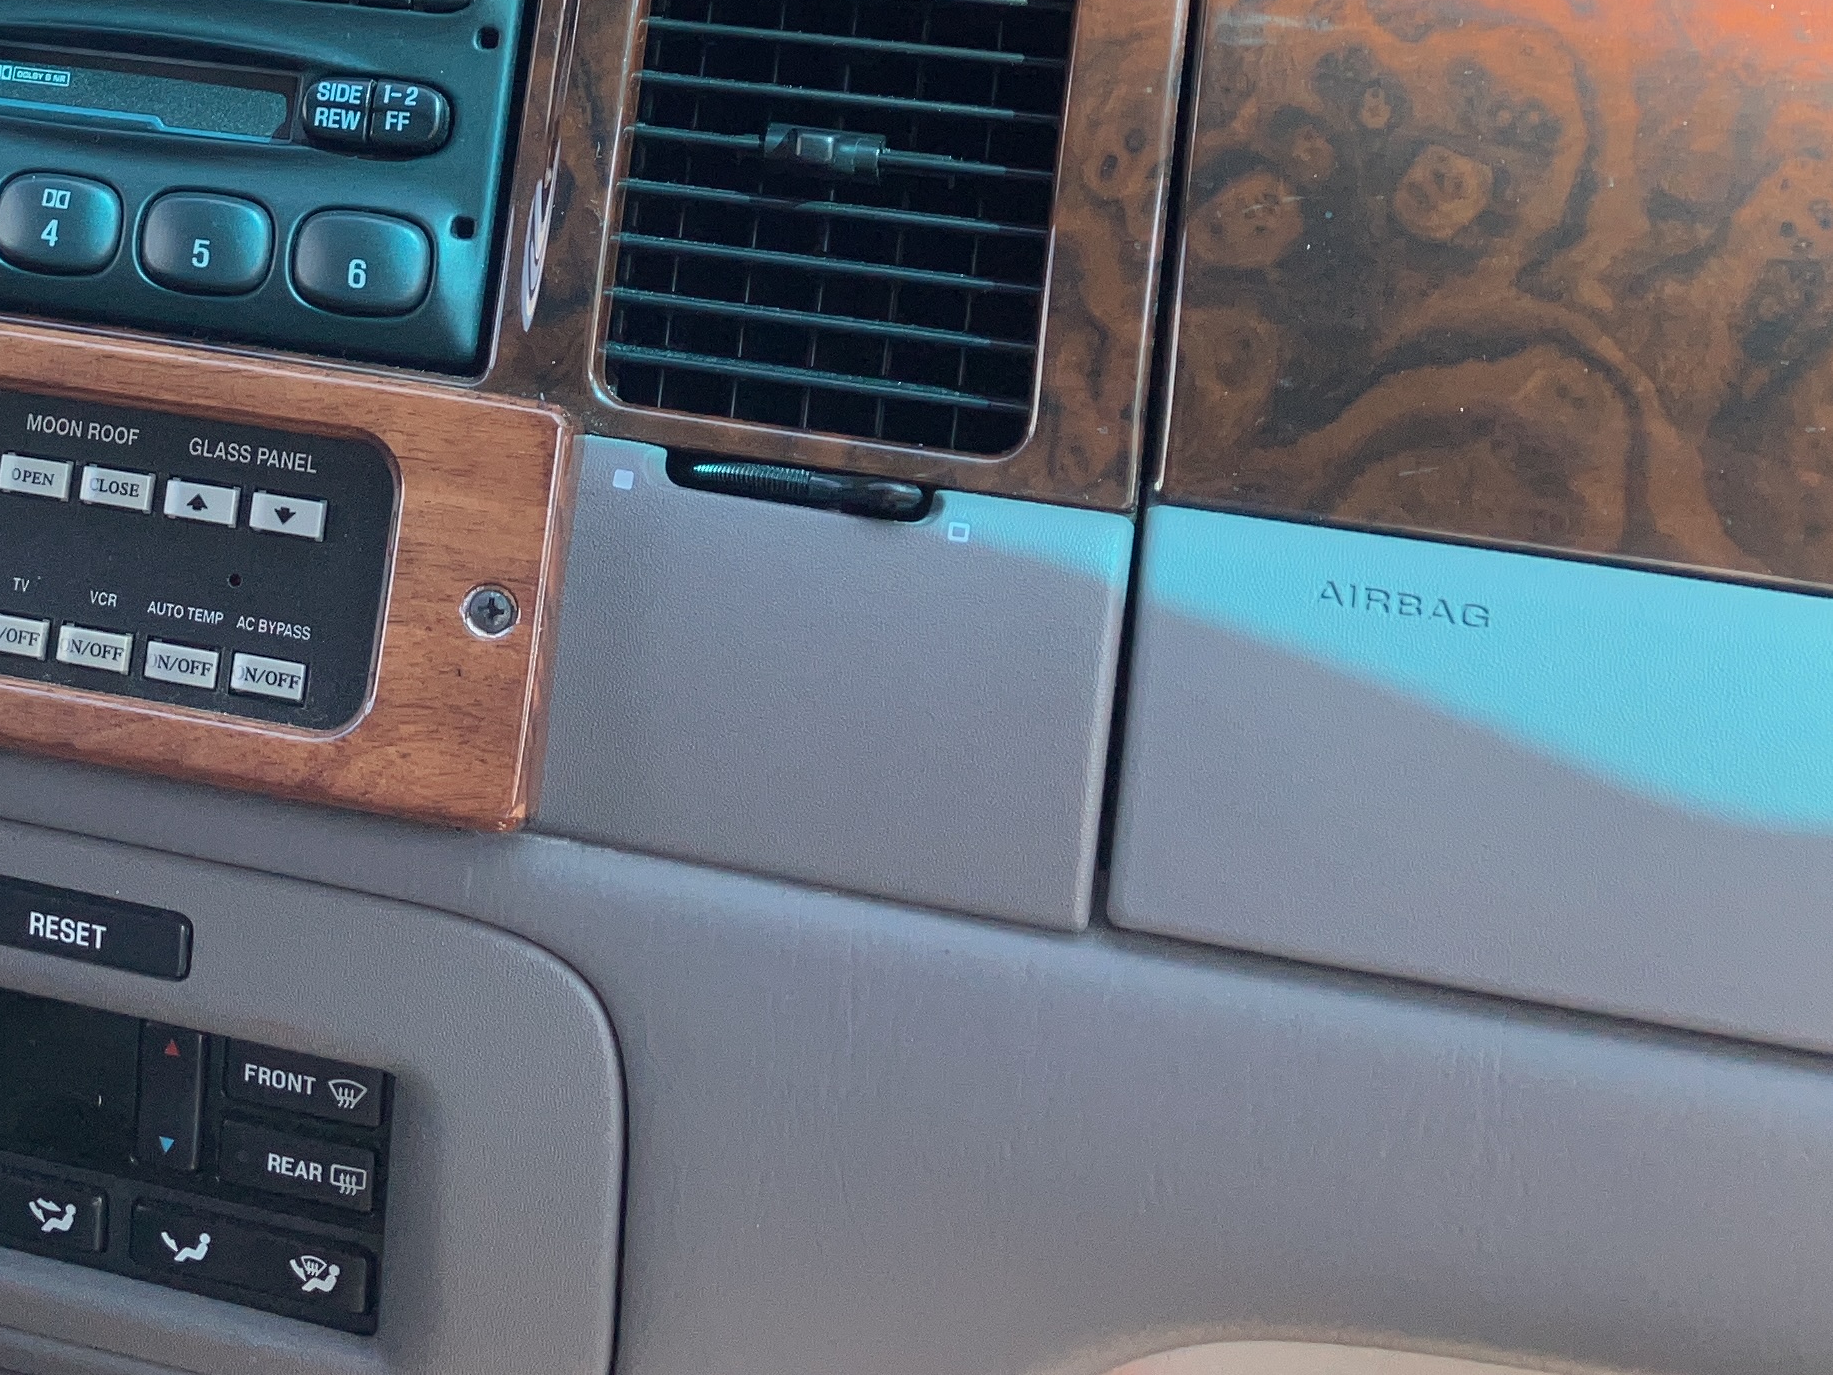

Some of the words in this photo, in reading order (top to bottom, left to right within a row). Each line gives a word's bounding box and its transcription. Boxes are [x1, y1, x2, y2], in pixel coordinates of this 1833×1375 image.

[316, 81, 362, 106] SIDE
[314, 107, 361, 132] REW
[384, 110, 411, 132] FF
[40, 217, 59, 248] 4
[191, 238, 210, 269] 5
[347, 258, 366, 289] 6
[26, 413, 83, 439] MOON
[87, 422, 140, 446] ROOF
[189, 437, 252, 464] GLASS
[256, 447, 317, 474] PANEL
[11, 467, 56, 486] OPEN
[89, 477, 140, 499] CLOSE
[13, 577, 30, 592] TV
[90, 590, 117, 607] VCR
[147, 601, 184, 618] AUTO
[187, 607, 224, 625] TEMP
[1320, 580, 1490, 628] AIRBAG
[236, 615, 255, 632] AC
[258, 619, 311, 641] BYPASS
[29, 912, 107, 951] RESET
[243, 1063, 316, 1097] FRONT
[267, 1151, 323, 1184] REAR
